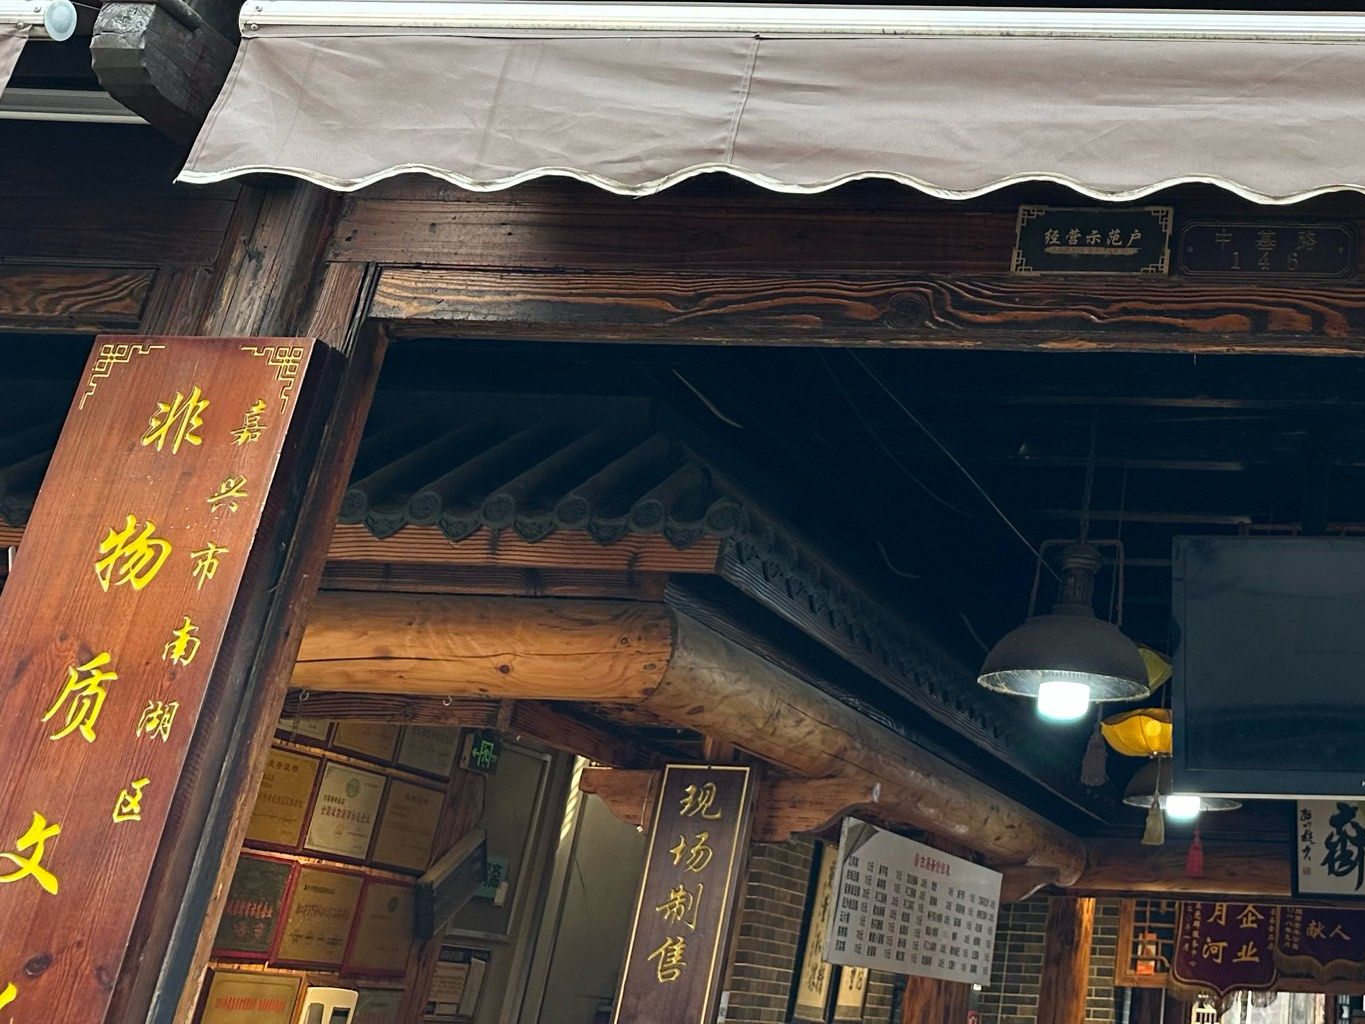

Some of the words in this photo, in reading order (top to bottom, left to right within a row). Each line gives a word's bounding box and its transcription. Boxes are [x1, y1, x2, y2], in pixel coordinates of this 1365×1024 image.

[1044, 228, 1142, 246] 经营示范户
[0, 385, 210, 1024] 非物质文
[112, 398, 268, 824] 嘉兴市南湖区
[646, 781, 722, 984] 现场制售
